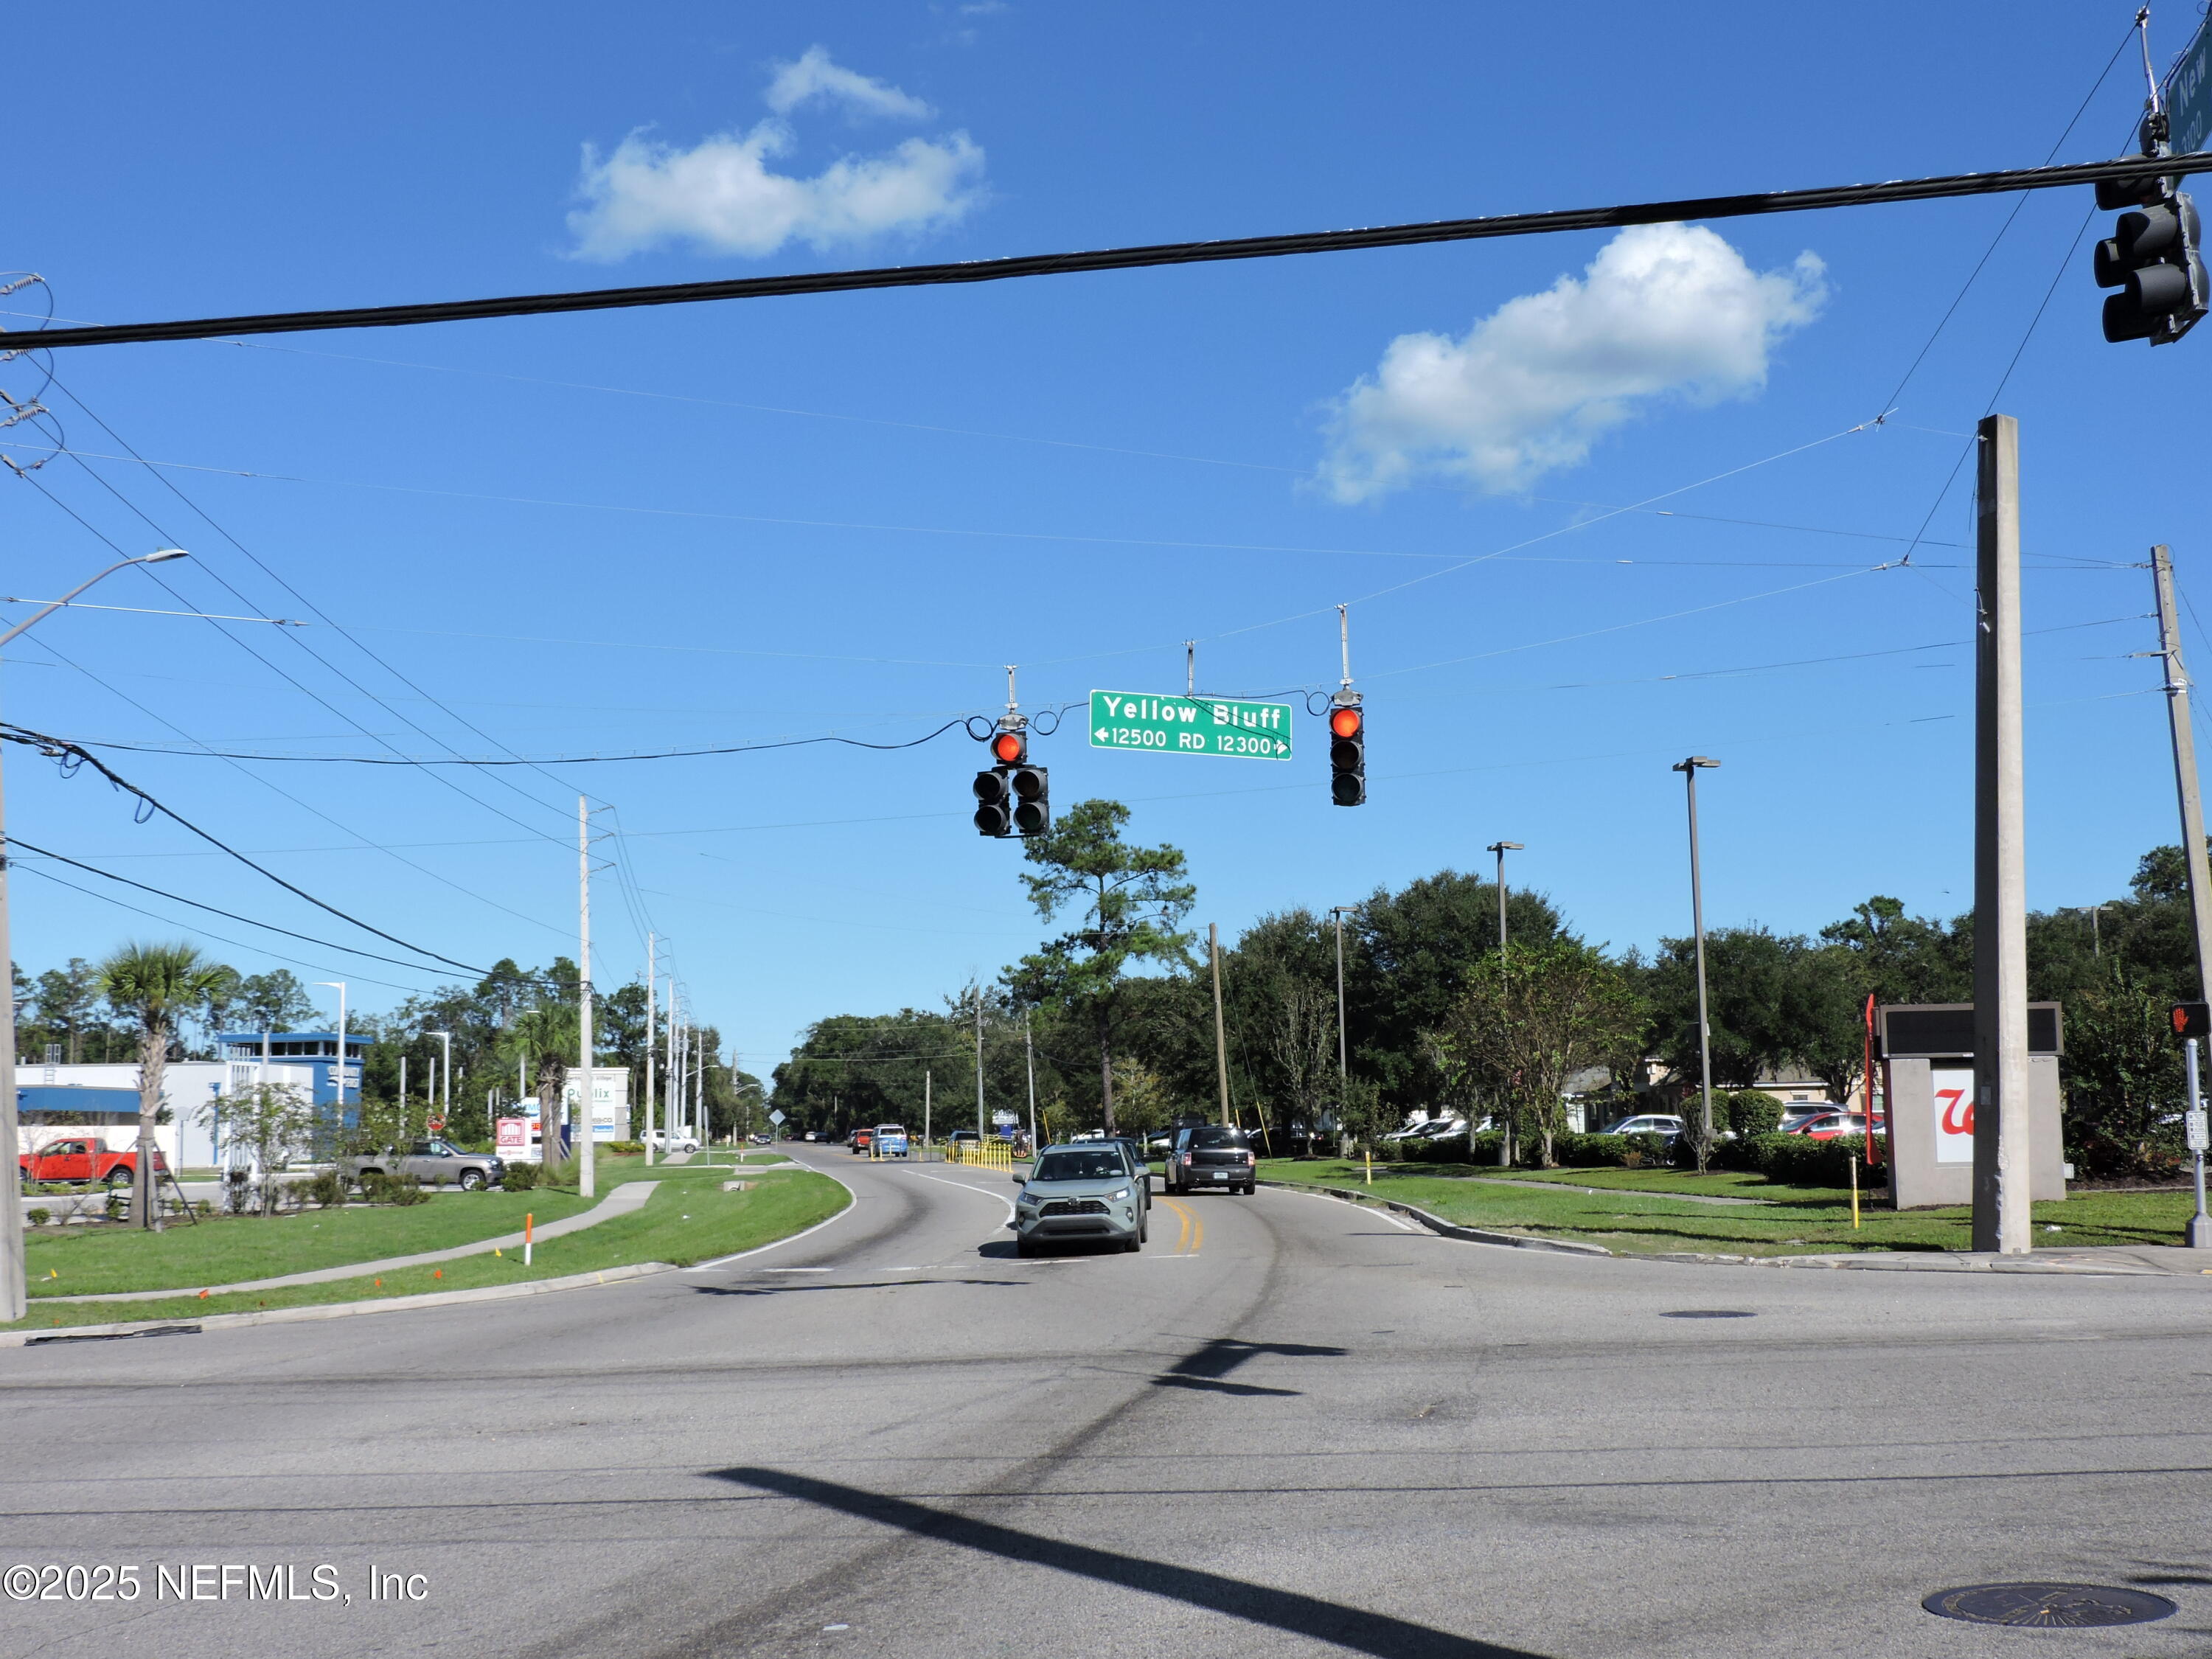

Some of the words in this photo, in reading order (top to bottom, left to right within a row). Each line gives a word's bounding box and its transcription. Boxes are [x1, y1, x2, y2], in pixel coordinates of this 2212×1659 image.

[2179, 46, 2206, 116] New
[1102, 695, 1197, 723] Yellow
[1213, 704, 1280, 728] Bluff
[1112, 727, 1166, 747] 12500
[1179, 732, 1206, 749] RD
[1217, 735, 1270, 754] 12300
